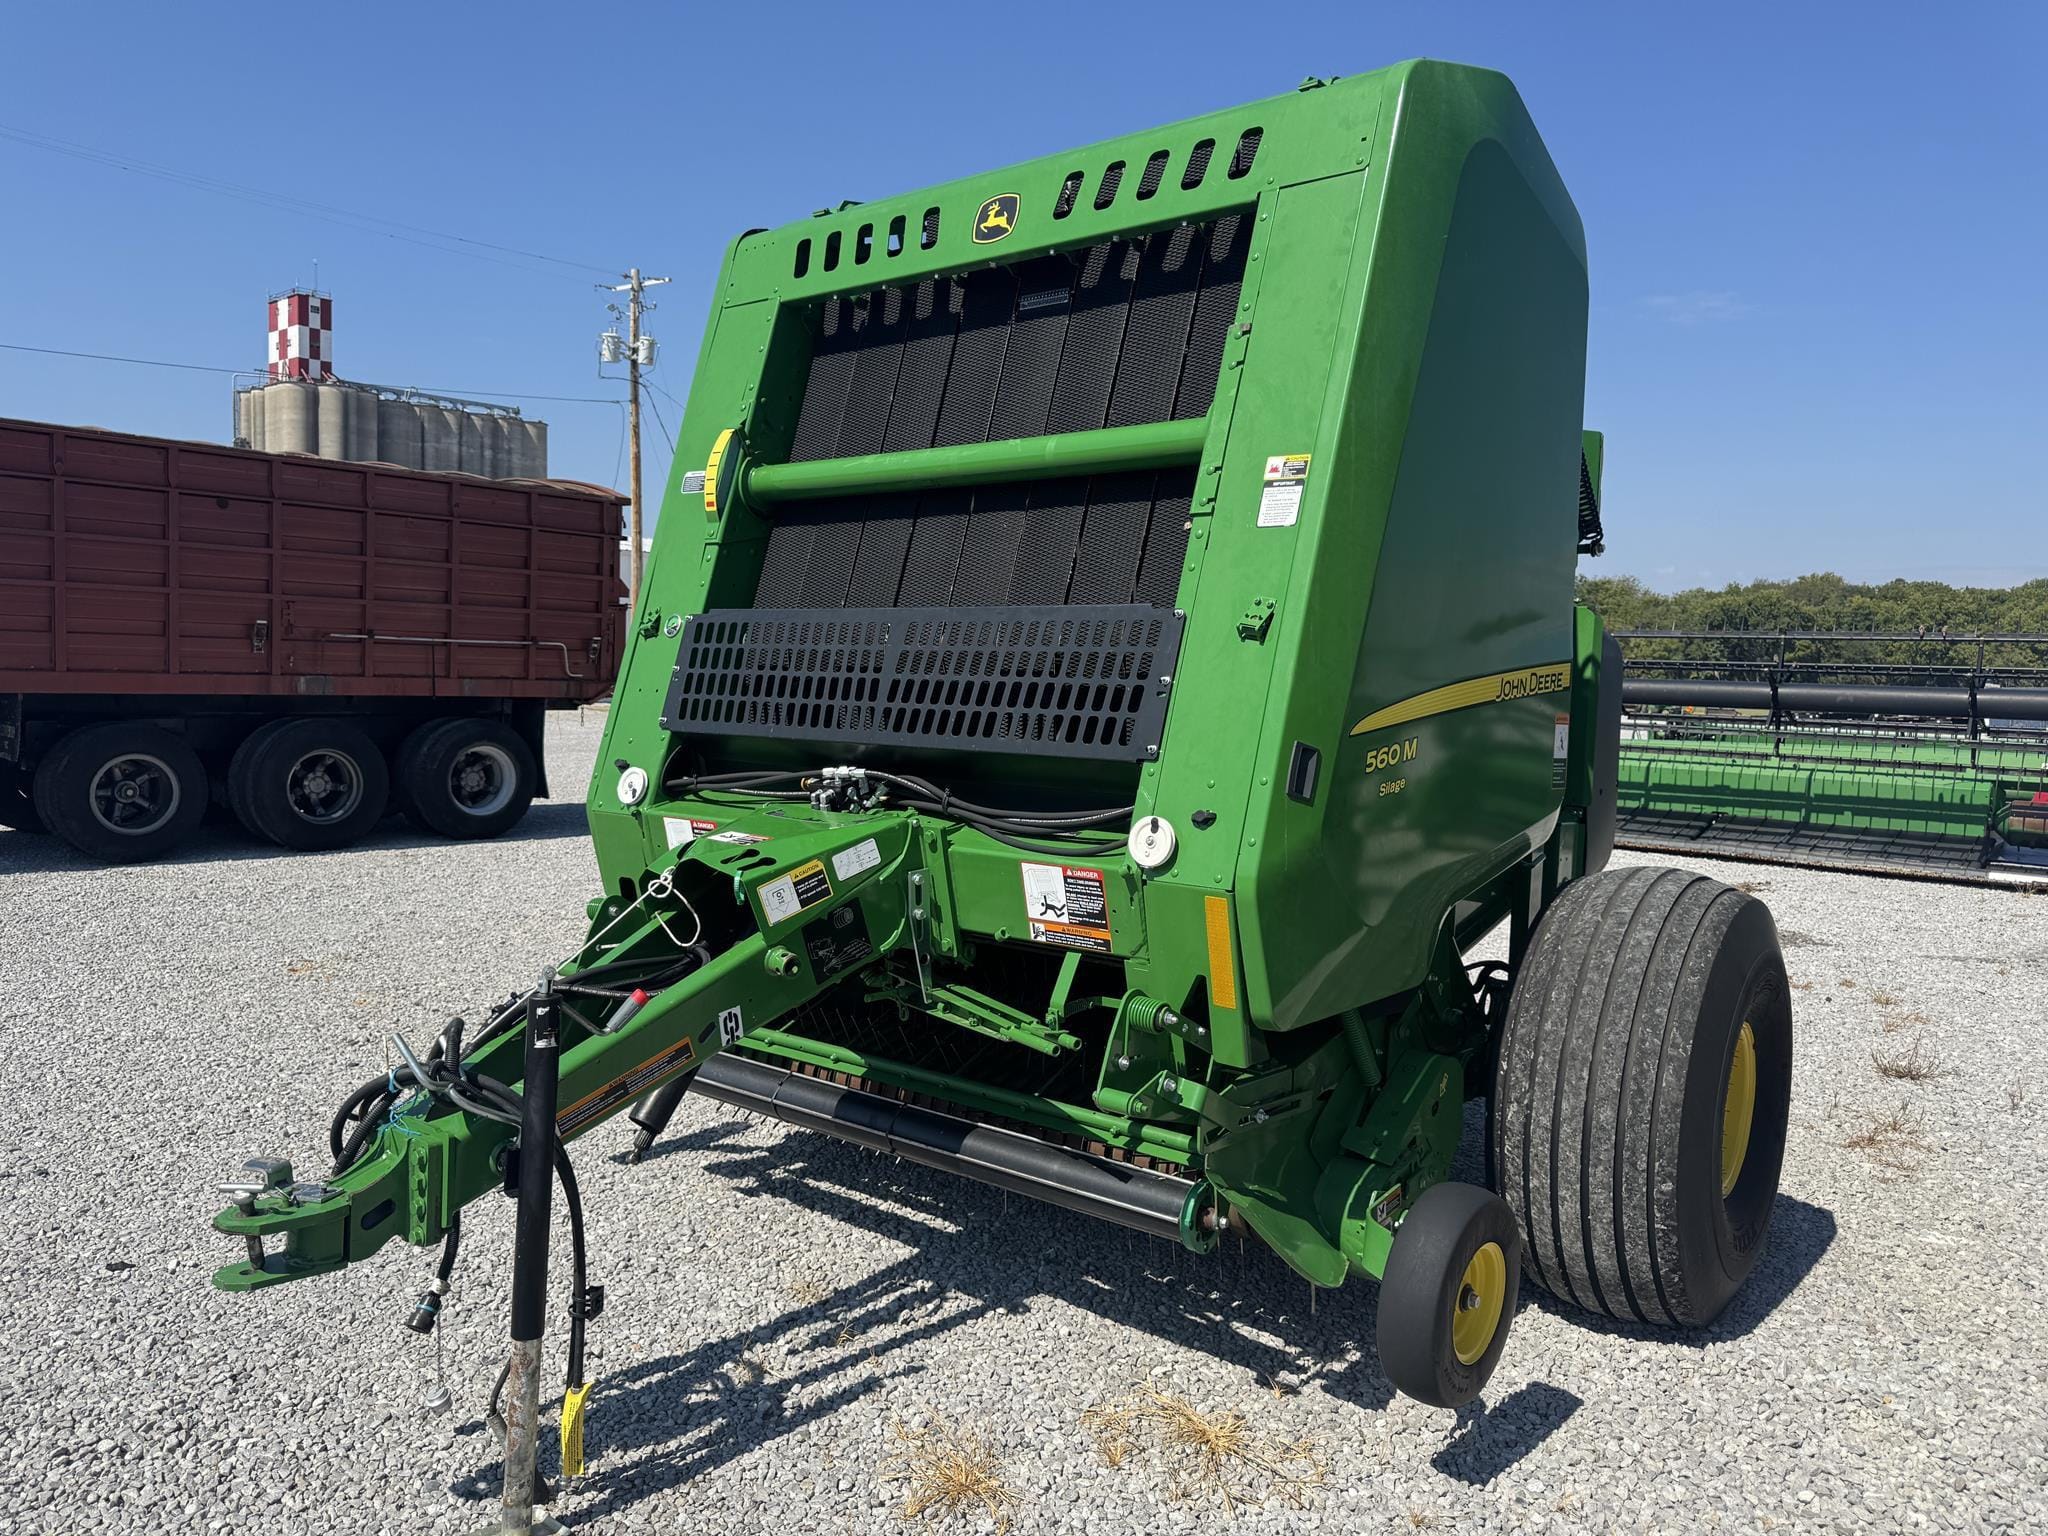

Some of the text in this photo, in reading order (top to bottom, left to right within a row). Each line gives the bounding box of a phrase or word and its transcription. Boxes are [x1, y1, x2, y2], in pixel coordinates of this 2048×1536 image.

[1496, 672, 1563, 699] JOHN DEERE
[1365, 737, 1418, 774] 560 M
[1379, 776, 1406, 797] Silage
[798, 863, 819, 877] CAUTION
[1072, 870, 1098, 879] DANGER
[1065, 927, 1092, 936] WARNING
